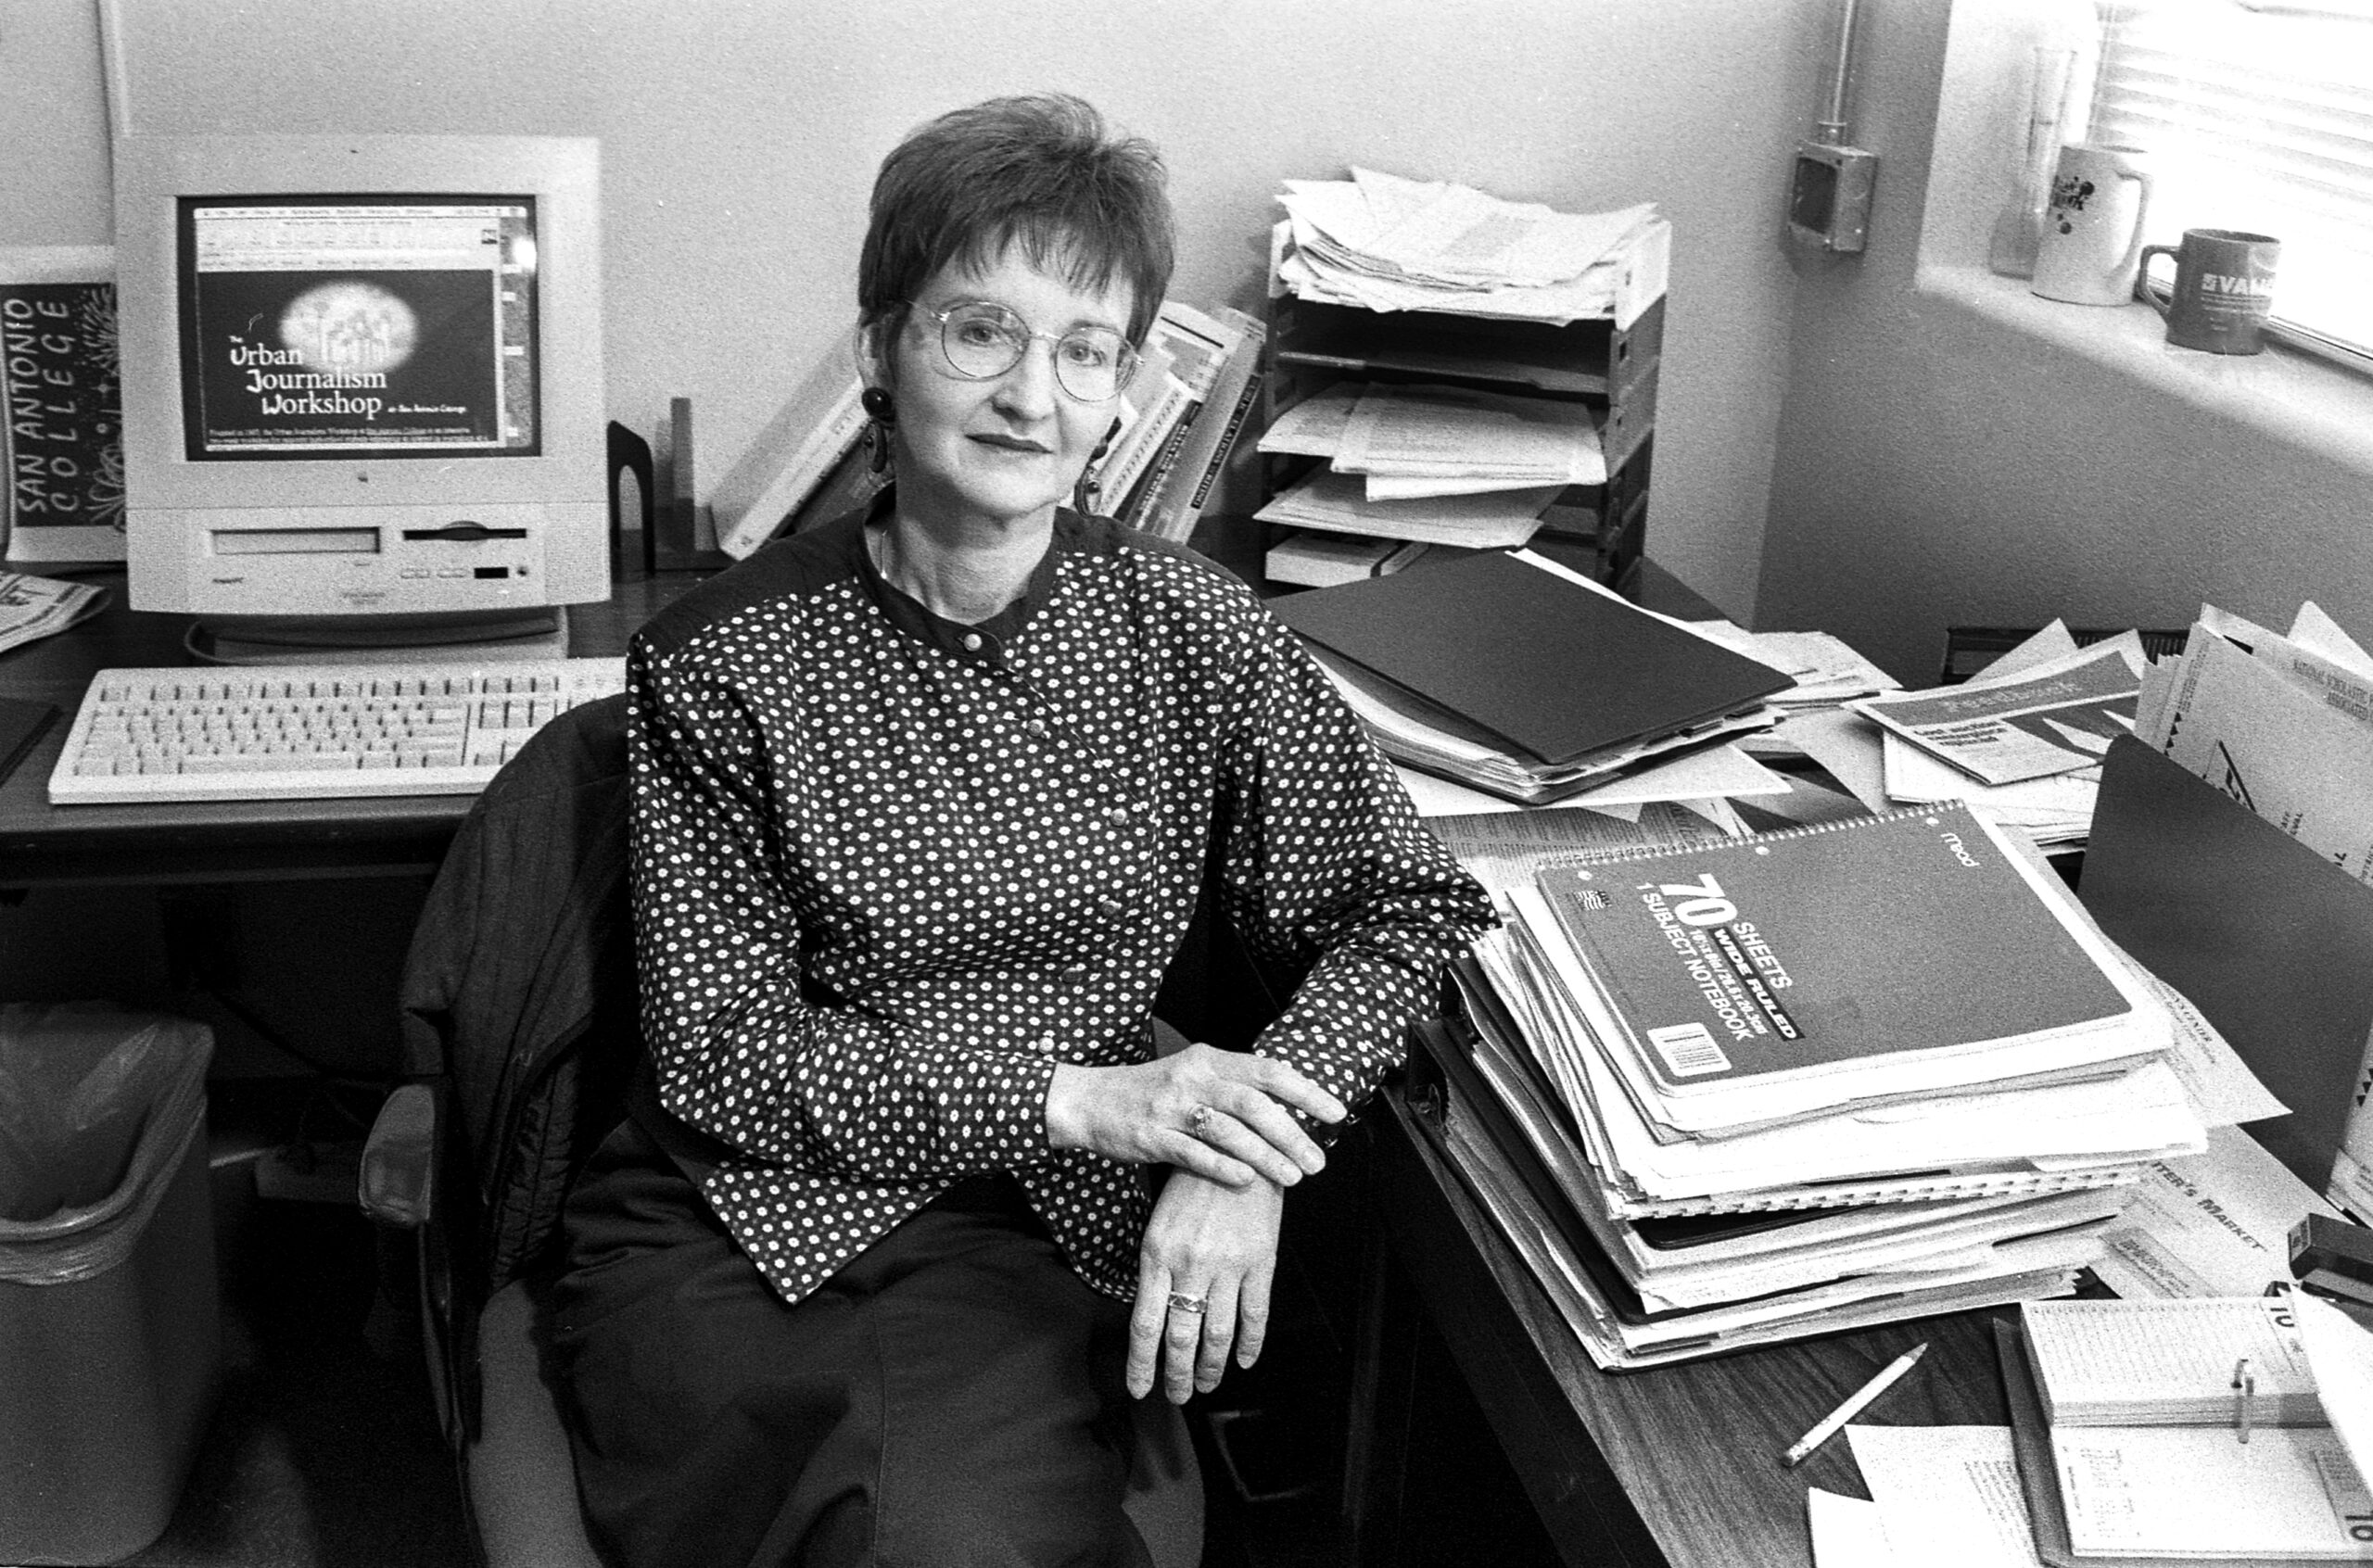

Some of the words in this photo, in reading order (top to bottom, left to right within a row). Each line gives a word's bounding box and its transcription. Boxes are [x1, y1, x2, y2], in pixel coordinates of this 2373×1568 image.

[3, 298, 45, 440] ANTONIO
[230, 343, 303, 366] Urban
[246, 368, 387, 393] Journalism
[35, 301, 79, 512] COLLEGE
[261, 390, 383, 420] Workshop
[16, 454, 46, 512] SAN
[1659, 873, 1738, 927] 70
[1643, 892, 1698, 955] SUBJECT
[1683, 958, 1755, 1042] NOTEBOOK
[1714, 929, 1754, 976] WIDE
[1745, 978, 1797, 1039] RULED
[1732, 922, 1793, 989] SHEETS
[2151, 1161, 2198, 1197] ITER'S
[2197, 1198, 2267, 1252] MARKET
